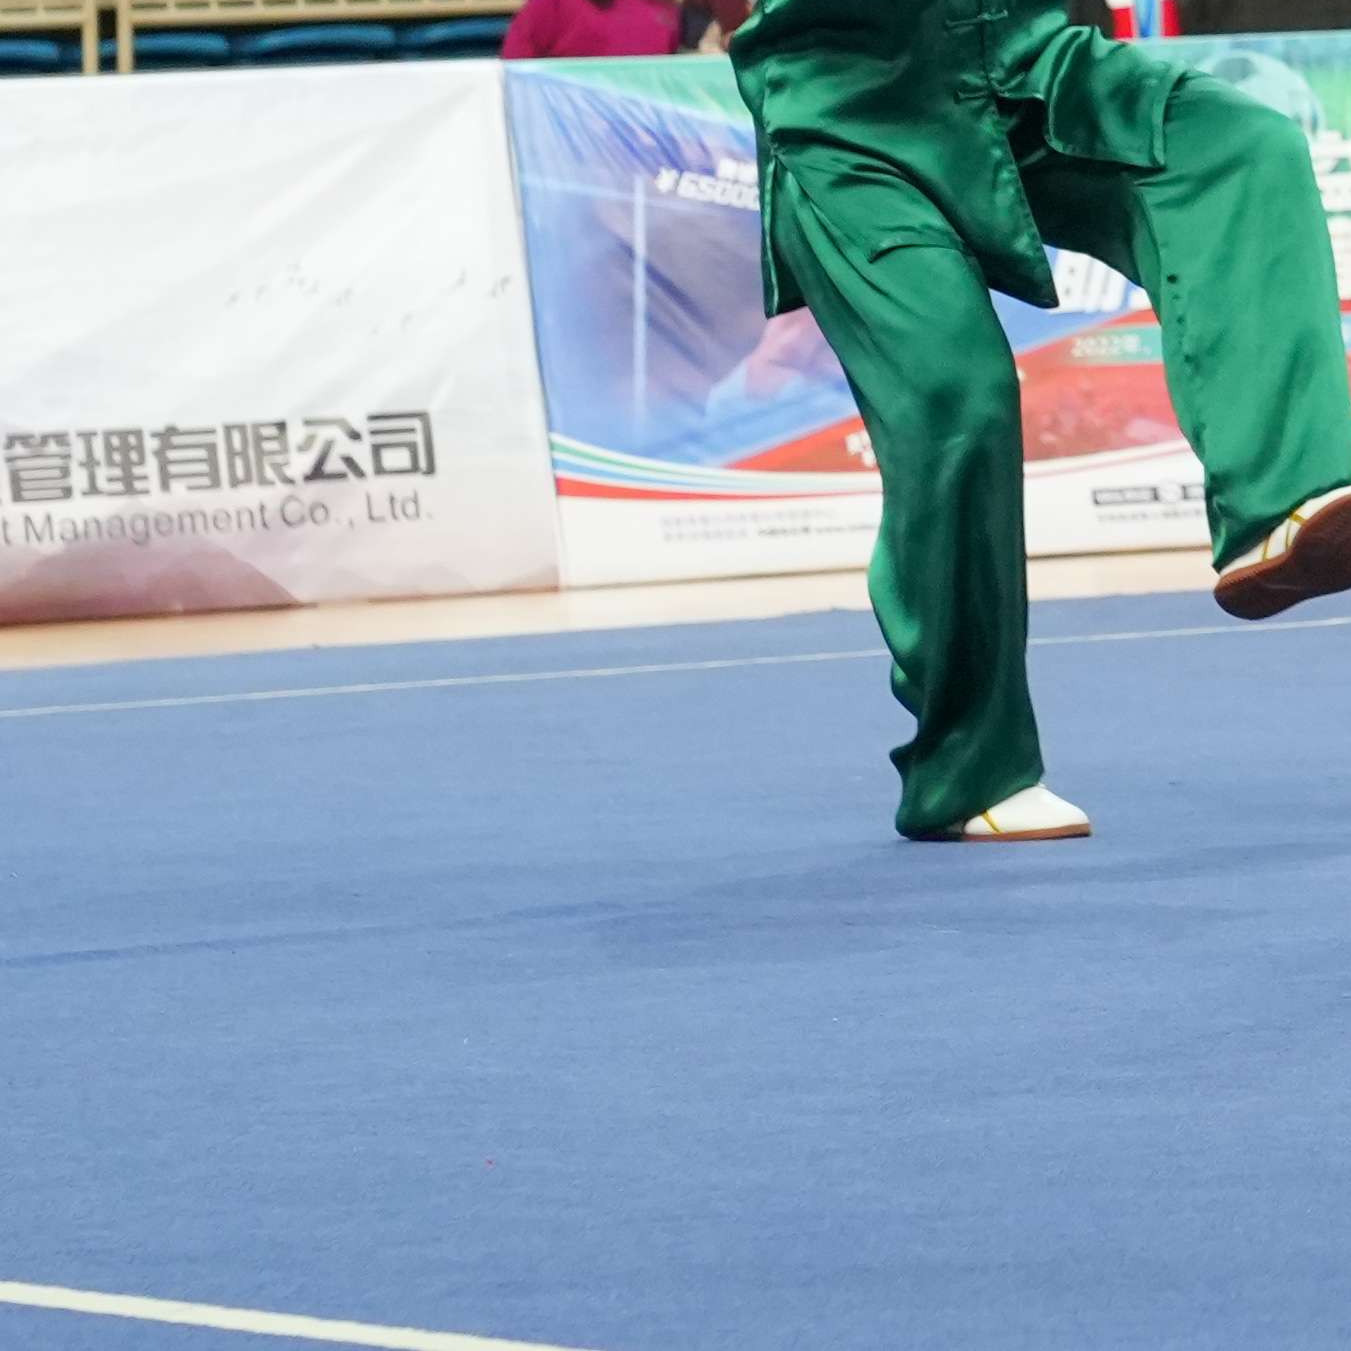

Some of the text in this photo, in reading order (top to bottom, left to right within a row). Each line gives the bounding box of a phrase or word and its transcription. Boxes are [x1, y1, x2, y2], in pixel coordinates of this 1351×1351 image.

[4, 411, 436, 503] 管理有限公司
[24, 505, 269, 546] Management
[366, 490, 433, 524] Ltd.
